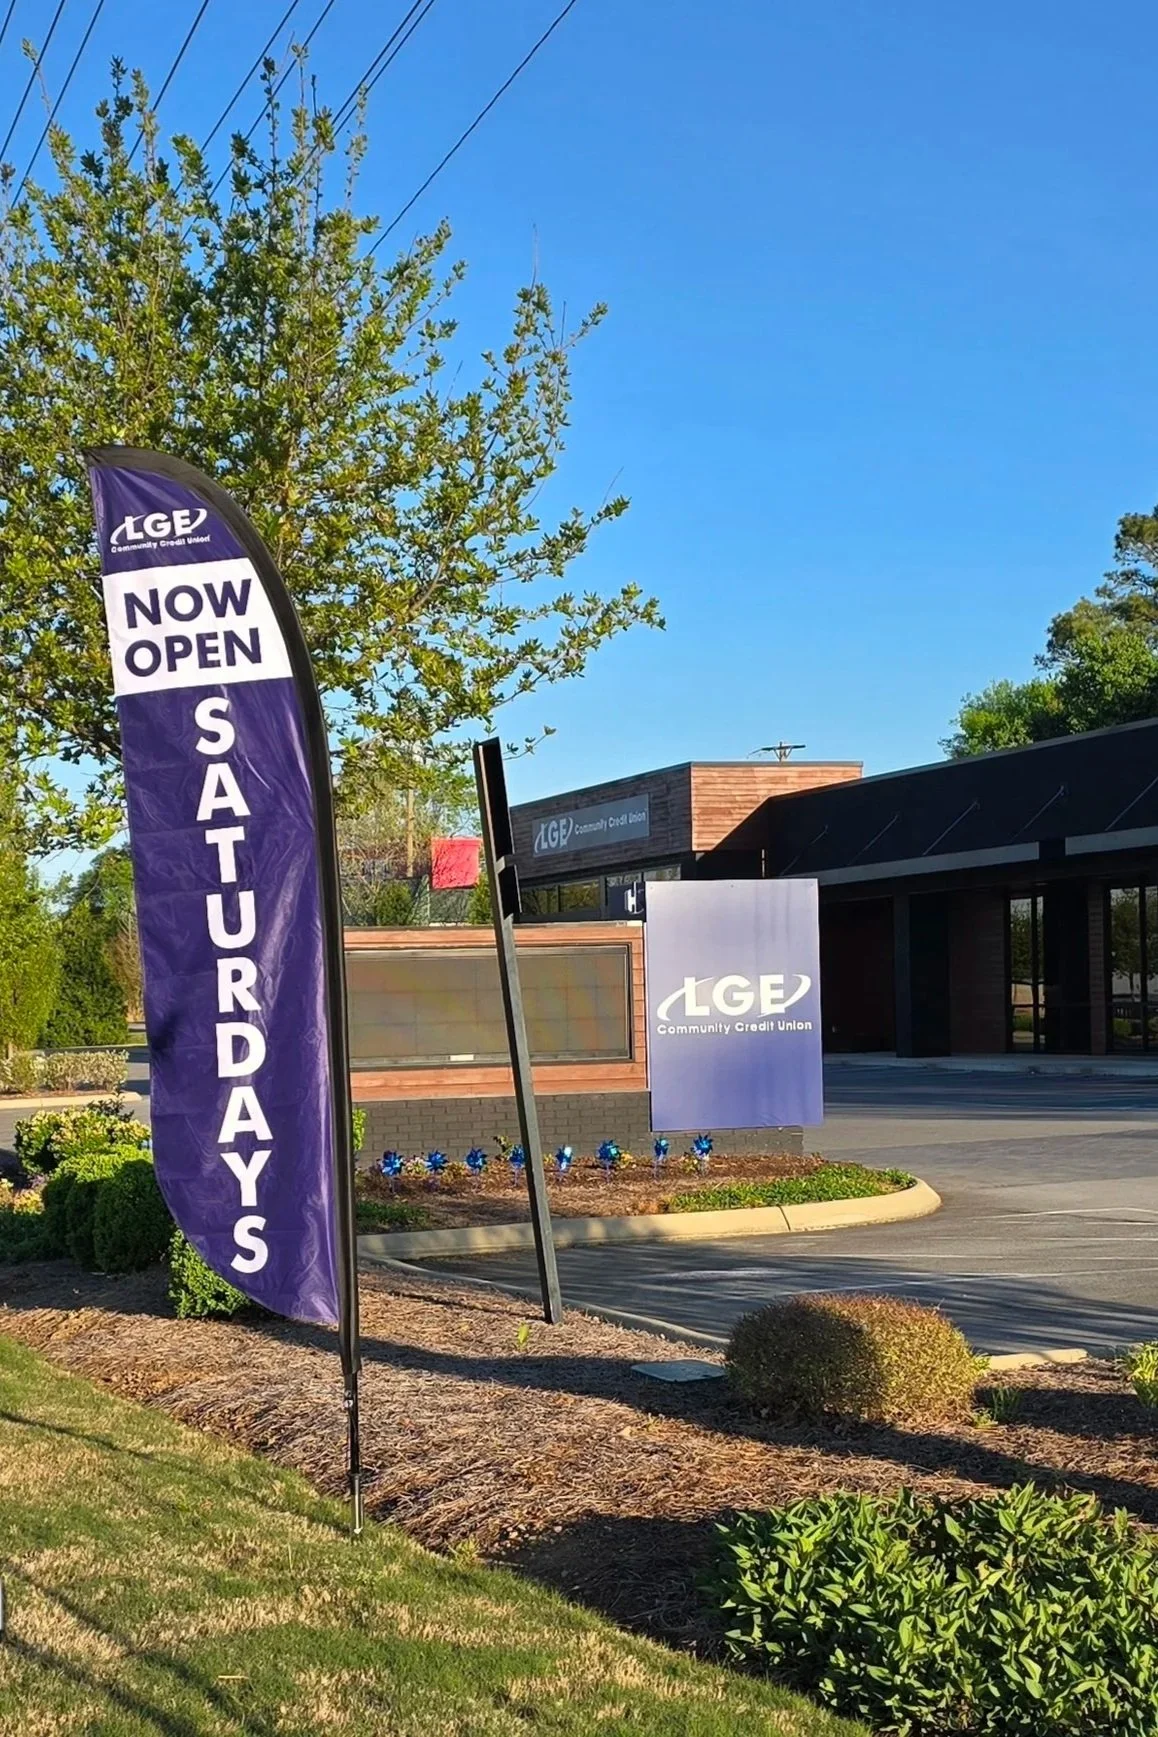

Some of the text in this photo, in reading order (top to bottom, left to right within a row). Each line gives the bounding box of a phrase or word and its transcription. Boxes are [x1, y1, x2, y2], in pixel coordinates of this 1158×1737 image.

[111, 535, 210, 553] Community Credit Union
[125, 509, 193, 540] LGE
[124, 578, 252, 629] NOW
[125, 627, 262, 677] OPEN
[540, 811, 646, 849] LGE Community Credit Union
[194, 696, 274, 1275] SATURDAYS
[683, 974, 786, 1017] LGE
[656, 1019, 812, 1035] Community Credit Union
